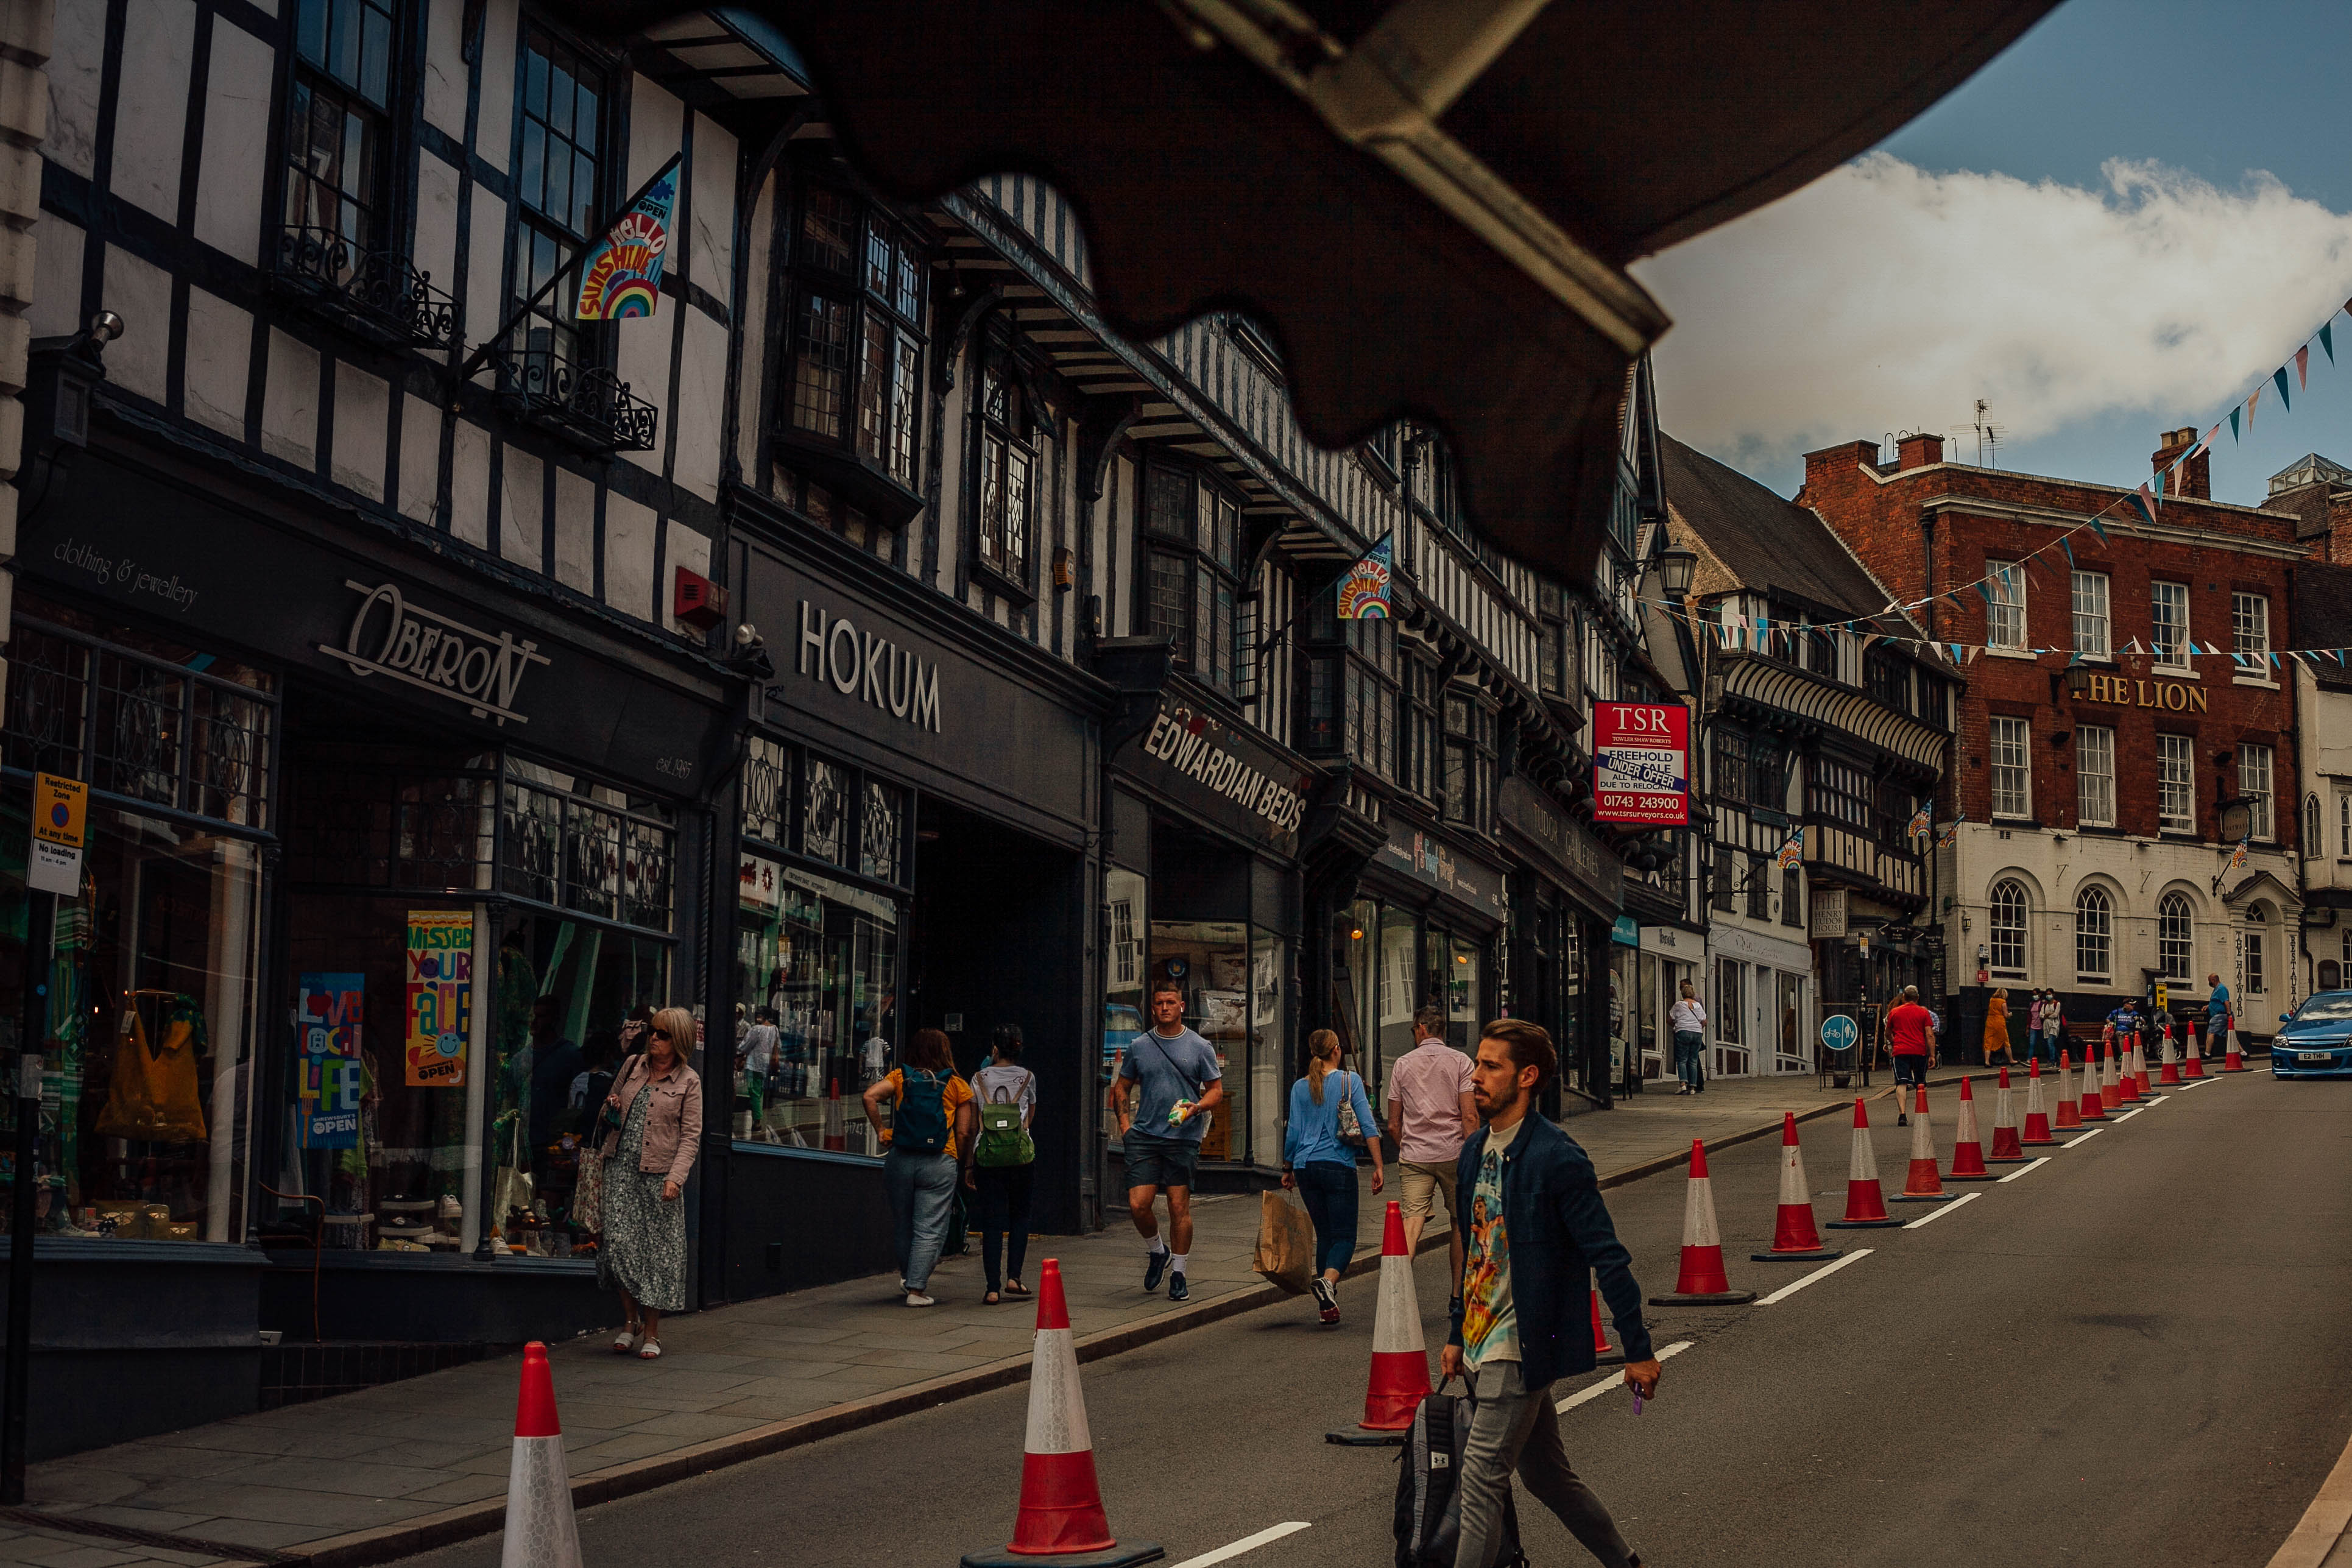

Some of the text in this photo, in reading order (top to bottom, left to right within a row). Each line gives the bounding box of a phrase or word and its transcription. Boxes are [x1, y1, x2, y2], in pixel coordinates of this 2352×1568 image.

[638, 201, 667, 220] OPEN
[54, 537, 198, 612] clothing & jewellery
[347, 583, 538, 727] OBERON
[800, 599, 941, 733] HOKUM
[2072, 674, 2208, 714] HE LION
[1612, 707, 1671, 733] TSR
[1609, 750, 1673, 762] FREEHOLD
[1144, 713, 1307, 833] EDWARDIAN BEDS
[1608, 757, 1675, 788] UNDER OFFER
[45, 777, 81, 793] Restricted
[54, 789, 71, 800] Zone
[1603, 794, 1679, 810] 01743 243900
[1597, 809, 1685, 820] www.tsrsurveyors.co.uk
[39, 827, 79, 842] At any time
[39, 843, 76, 860] No loading
[418, 1064, 454, 1079] OPEN
[313, 1118, 356, 1134] OPEN
